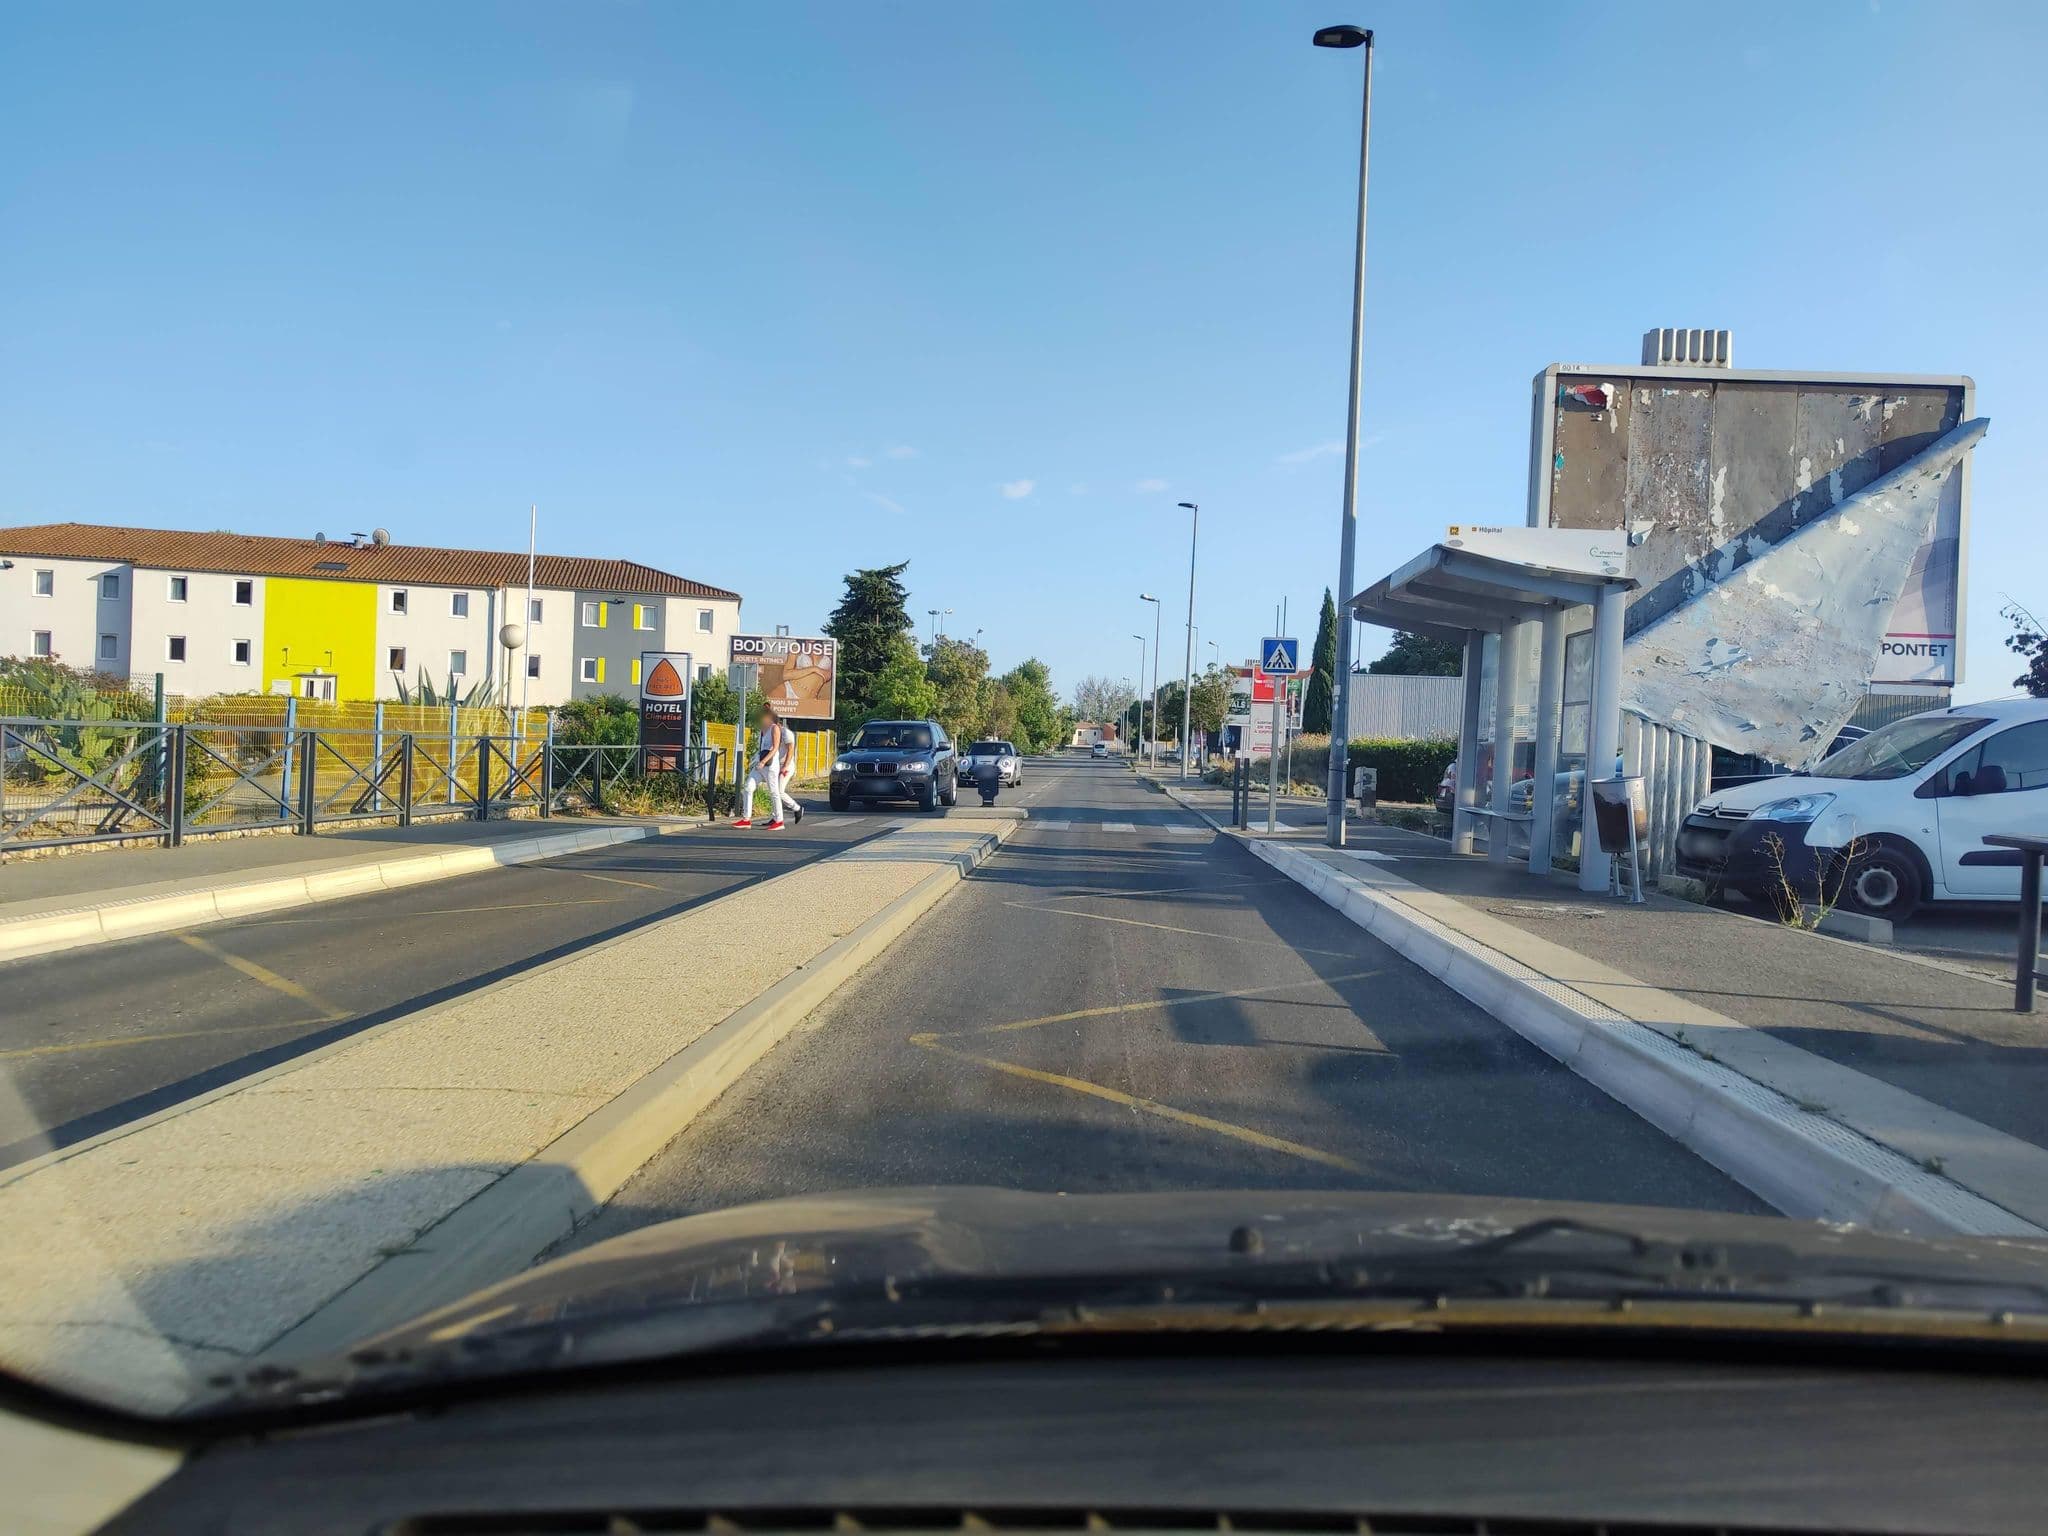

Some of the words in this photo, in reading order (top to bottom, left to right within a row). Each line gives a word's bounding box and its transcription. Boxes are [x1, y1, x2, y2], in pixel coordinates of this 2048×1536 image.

[733, 639, 833, 656] BODYHOUSE
[1881, 642, 1948, 657] PONTET
[646, 703, 682, 713] HOTEL
